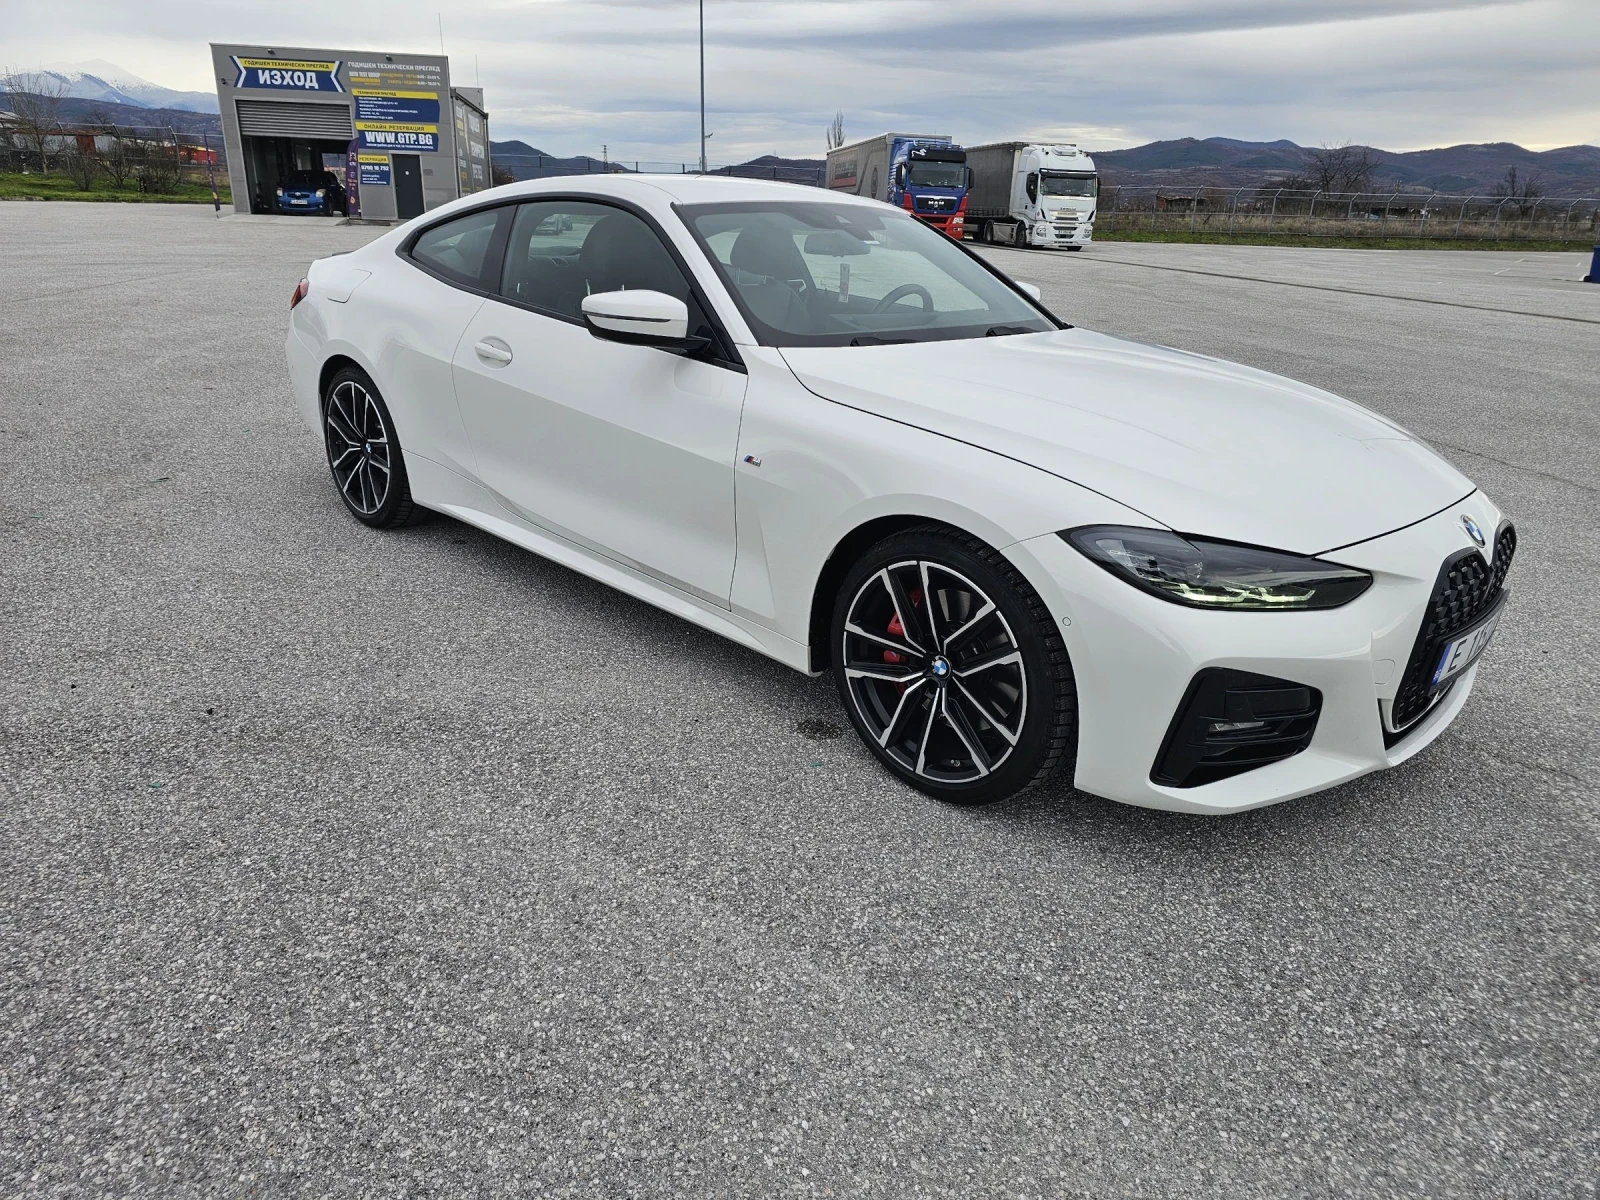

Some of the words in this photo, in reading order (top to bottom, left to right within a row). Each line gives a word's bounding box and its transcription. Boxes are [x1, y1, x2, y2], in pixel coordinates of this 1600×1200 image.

[348, 61, 376, 69] ГОДИШЕН
[258, 69, 319, 90] ИЗХОД
[365, 131, 433, 145] WWW.GTP.BG
[1447, 638, 1468, 672] E
